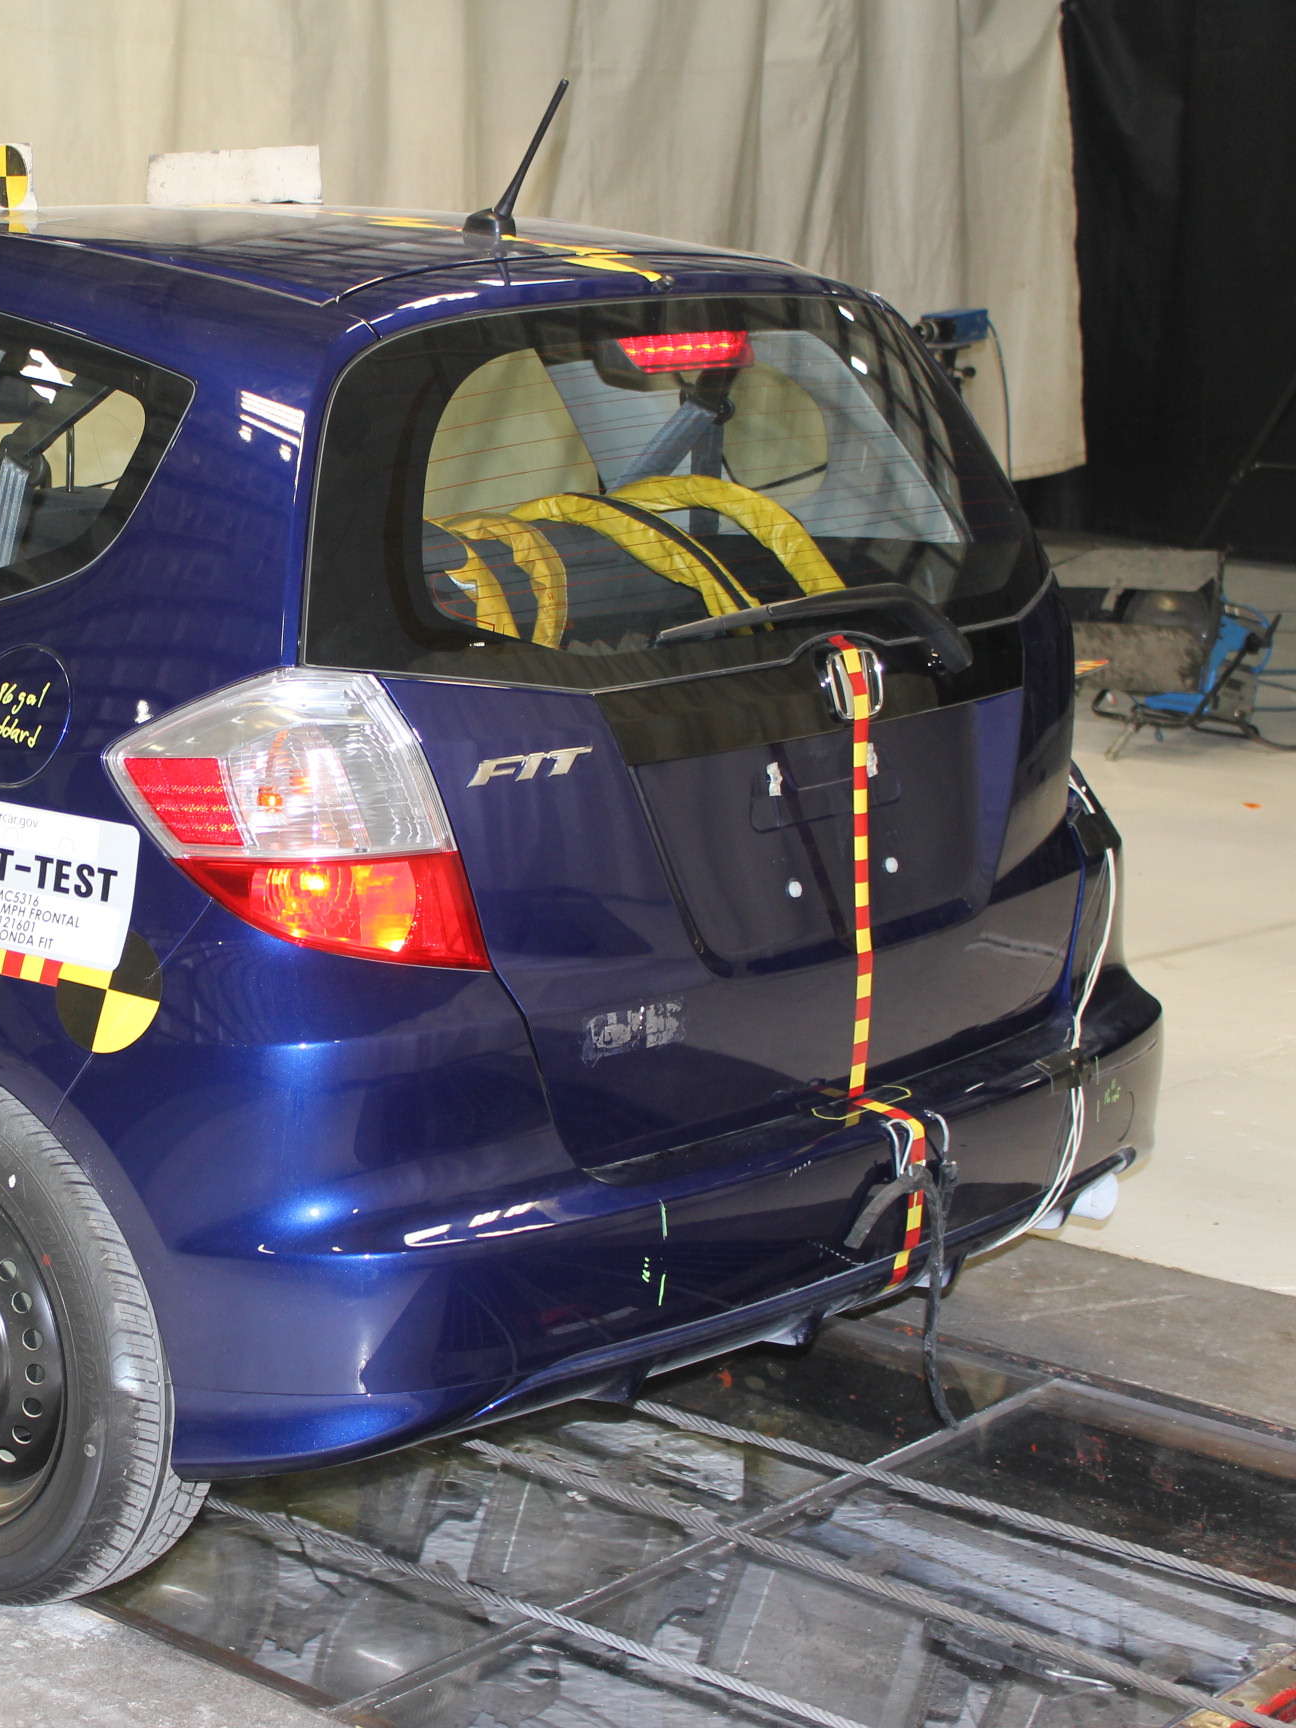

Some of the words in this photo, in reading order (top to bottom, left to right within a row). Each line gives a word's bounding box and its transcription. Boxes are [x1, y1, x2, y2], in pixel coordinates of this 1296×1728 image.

[11, 682, 51, 715] gal
[466, 745, 594, 788] FIT
[2, 904, 26, 917] MPH
[29, 908, 80, 929] FRONTAL
[38, 936, 54, 950] FIT
